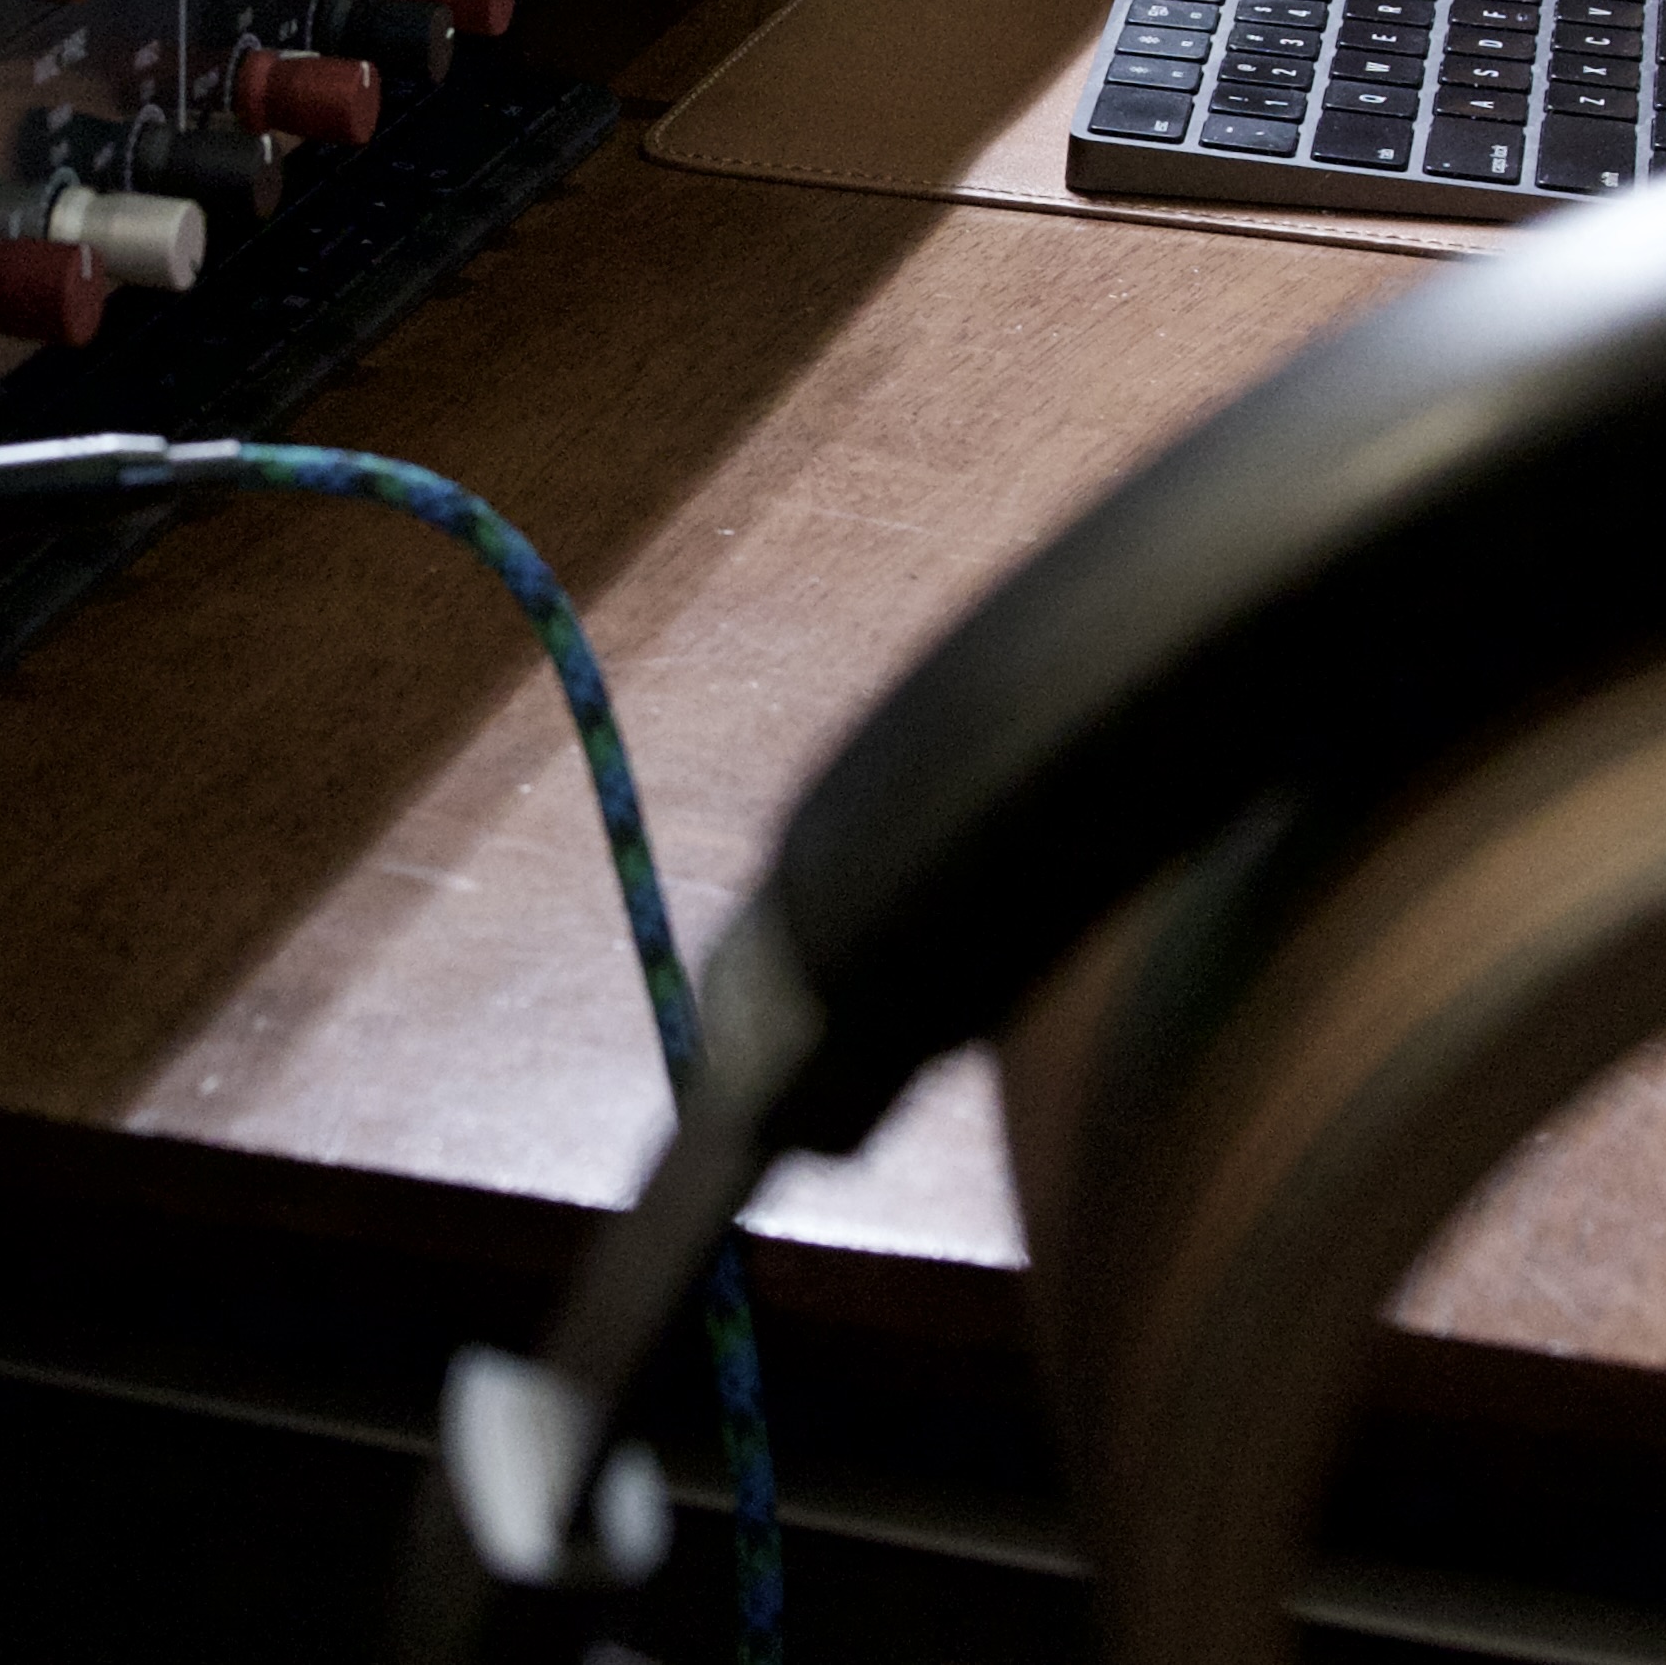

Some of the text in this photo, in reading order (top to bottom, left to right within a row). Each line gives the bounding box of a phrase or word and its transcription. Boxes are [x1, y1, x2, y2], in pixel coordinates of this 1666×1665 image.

[1288, 9, 1311, 18] 4
[1377, 5, 1402, 14] R
[1482, 10, 1506, 19] F
[1588, 7, 1612, 16] V
[1279, 38, 1305, 47] 3
[1371, 33, 1397, 43] E
[1584, 36, 1611, 46] C
[1478, 39, 1503, 49] D
[1365, 61, 1390, 73] W
[1583, 65, 1607, 76] X
[1271, 68, 1297, 77] 2
[1473, 68, 1500, 78] S
[1358, 94, 1387, 104] Q
[1579, 96, 1606, 106] Z
[1470, 100, 1494, 109] A
